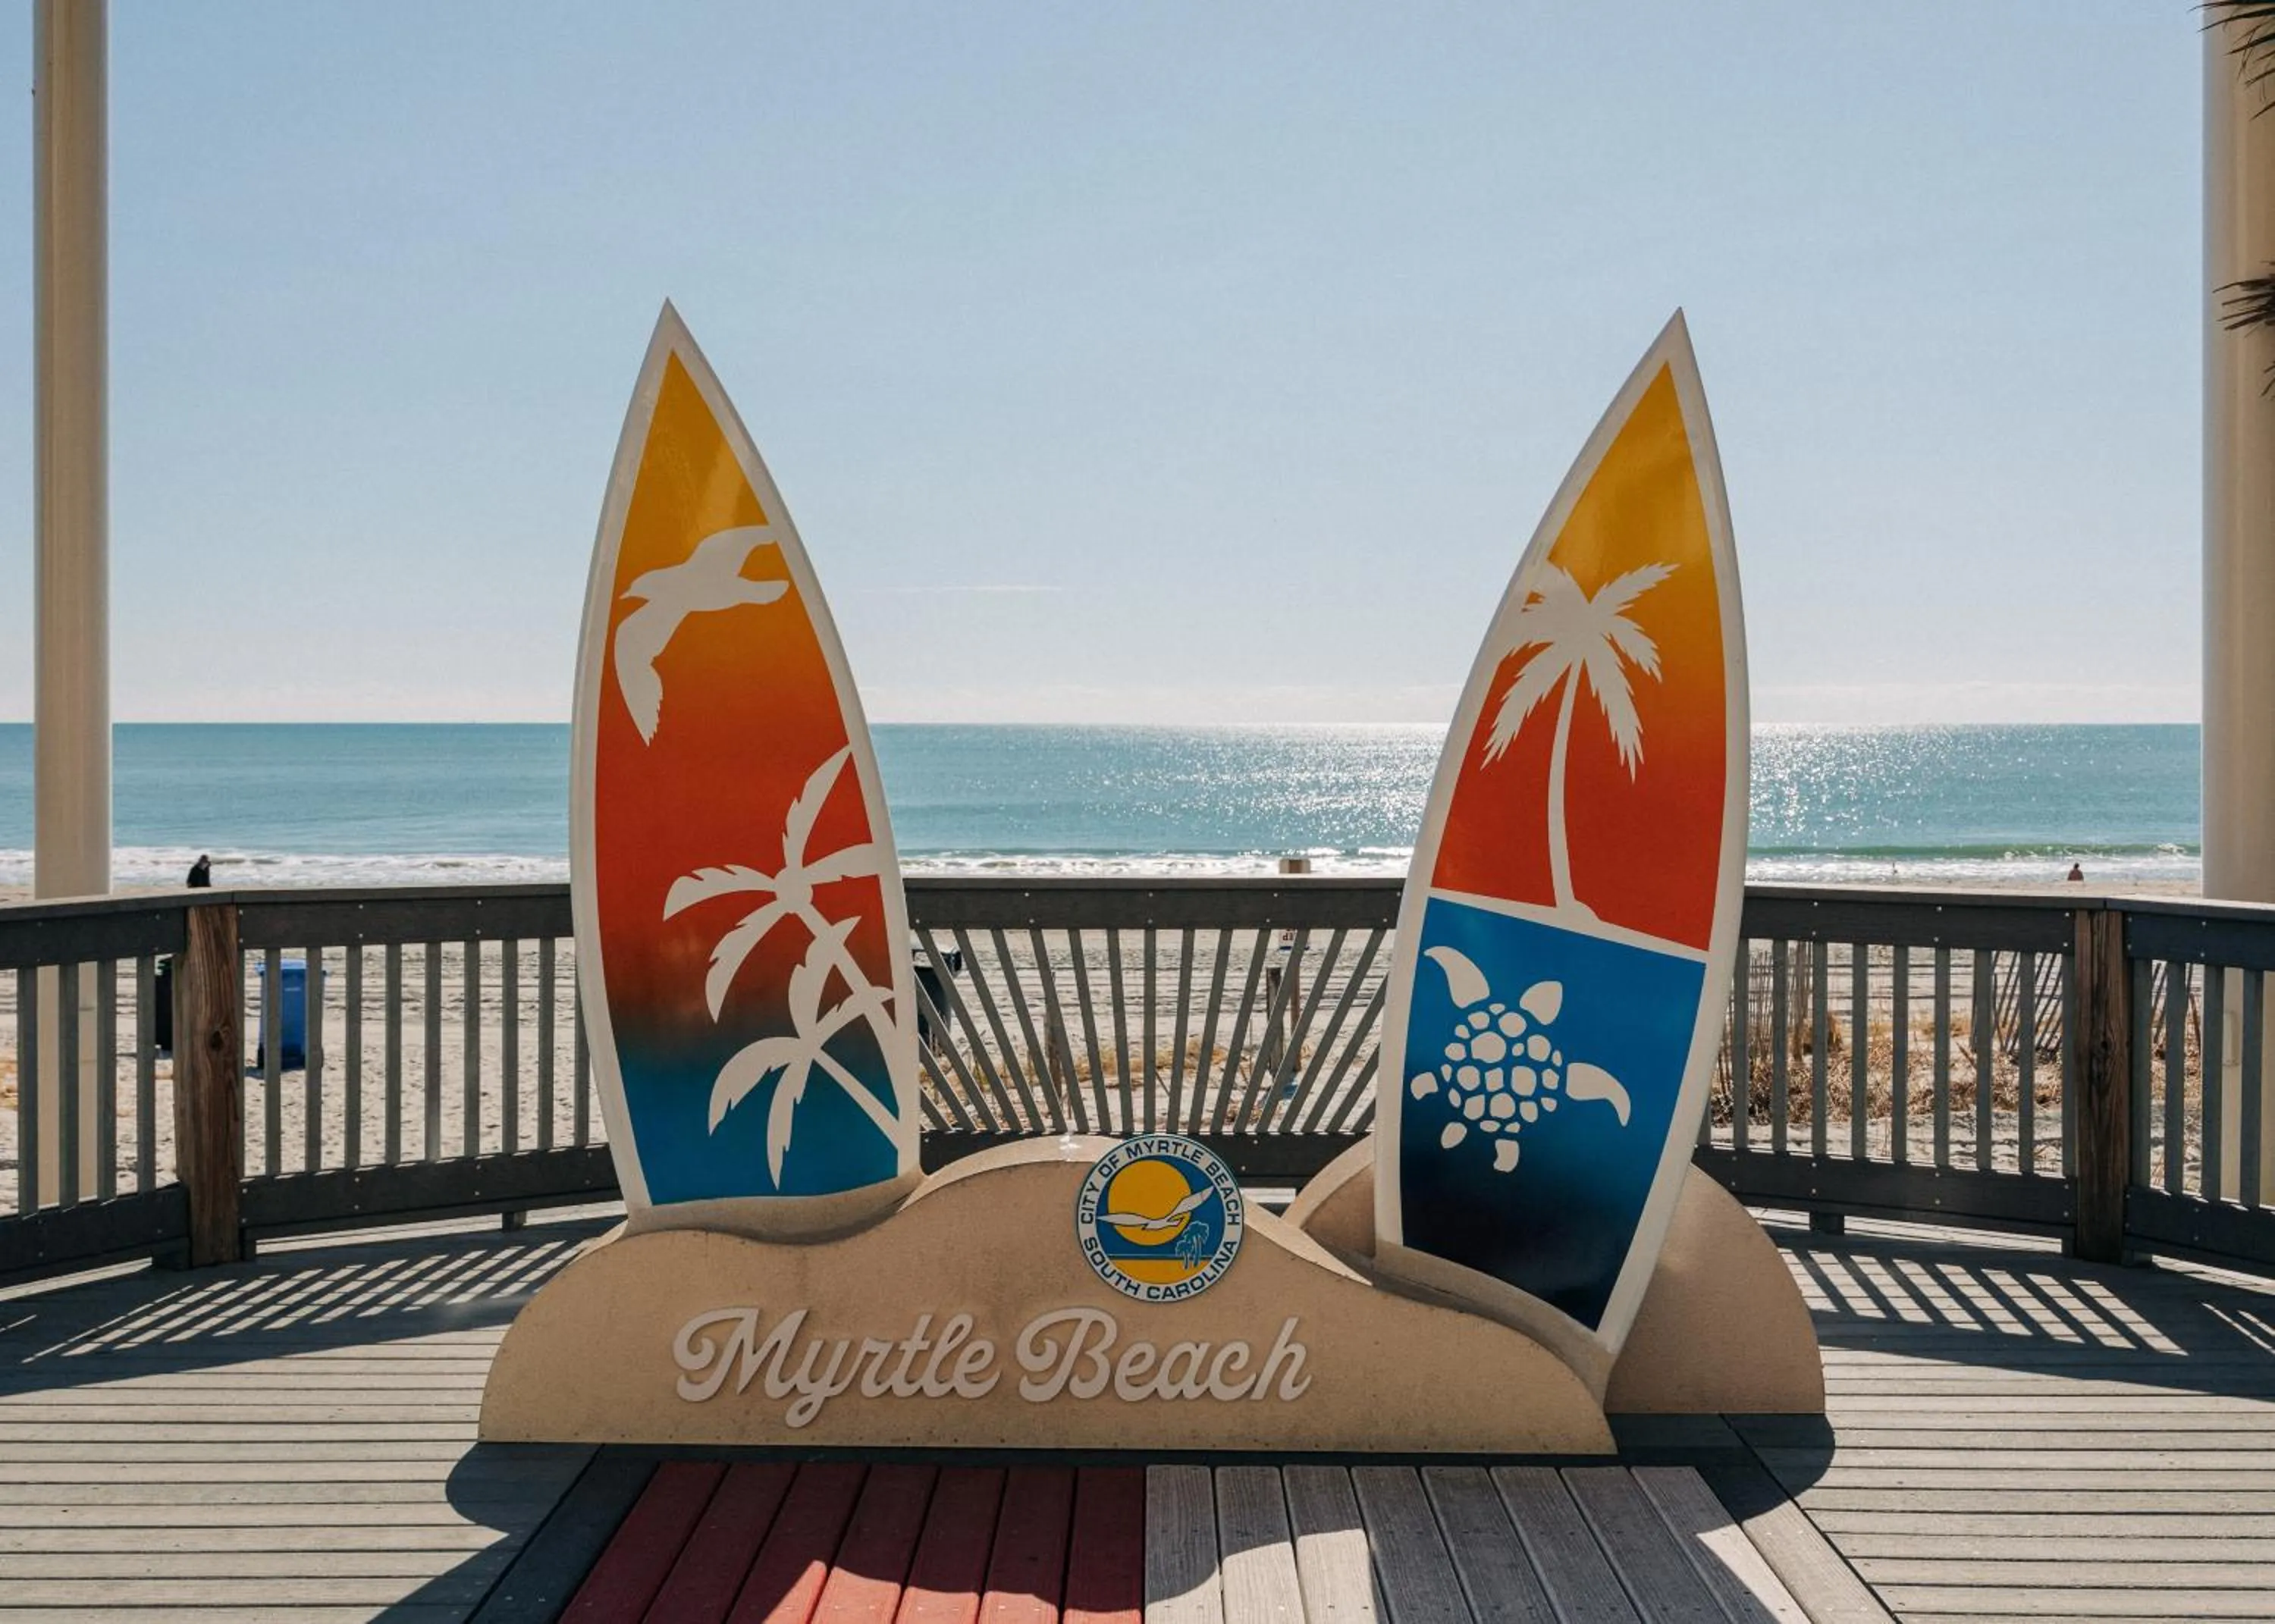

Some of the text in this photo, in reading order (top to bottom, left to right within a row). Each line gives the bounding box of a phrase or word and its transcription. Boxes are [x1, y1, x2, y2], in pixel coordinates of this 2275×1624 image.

[1081, 1140, 1240, 1226] CITY OF MYRTLE BEACH
[1084, 1237, 1237, 1300] SOUTH CAROLINA
[673, 1306, 1312, 1428] Myrtle Beach
